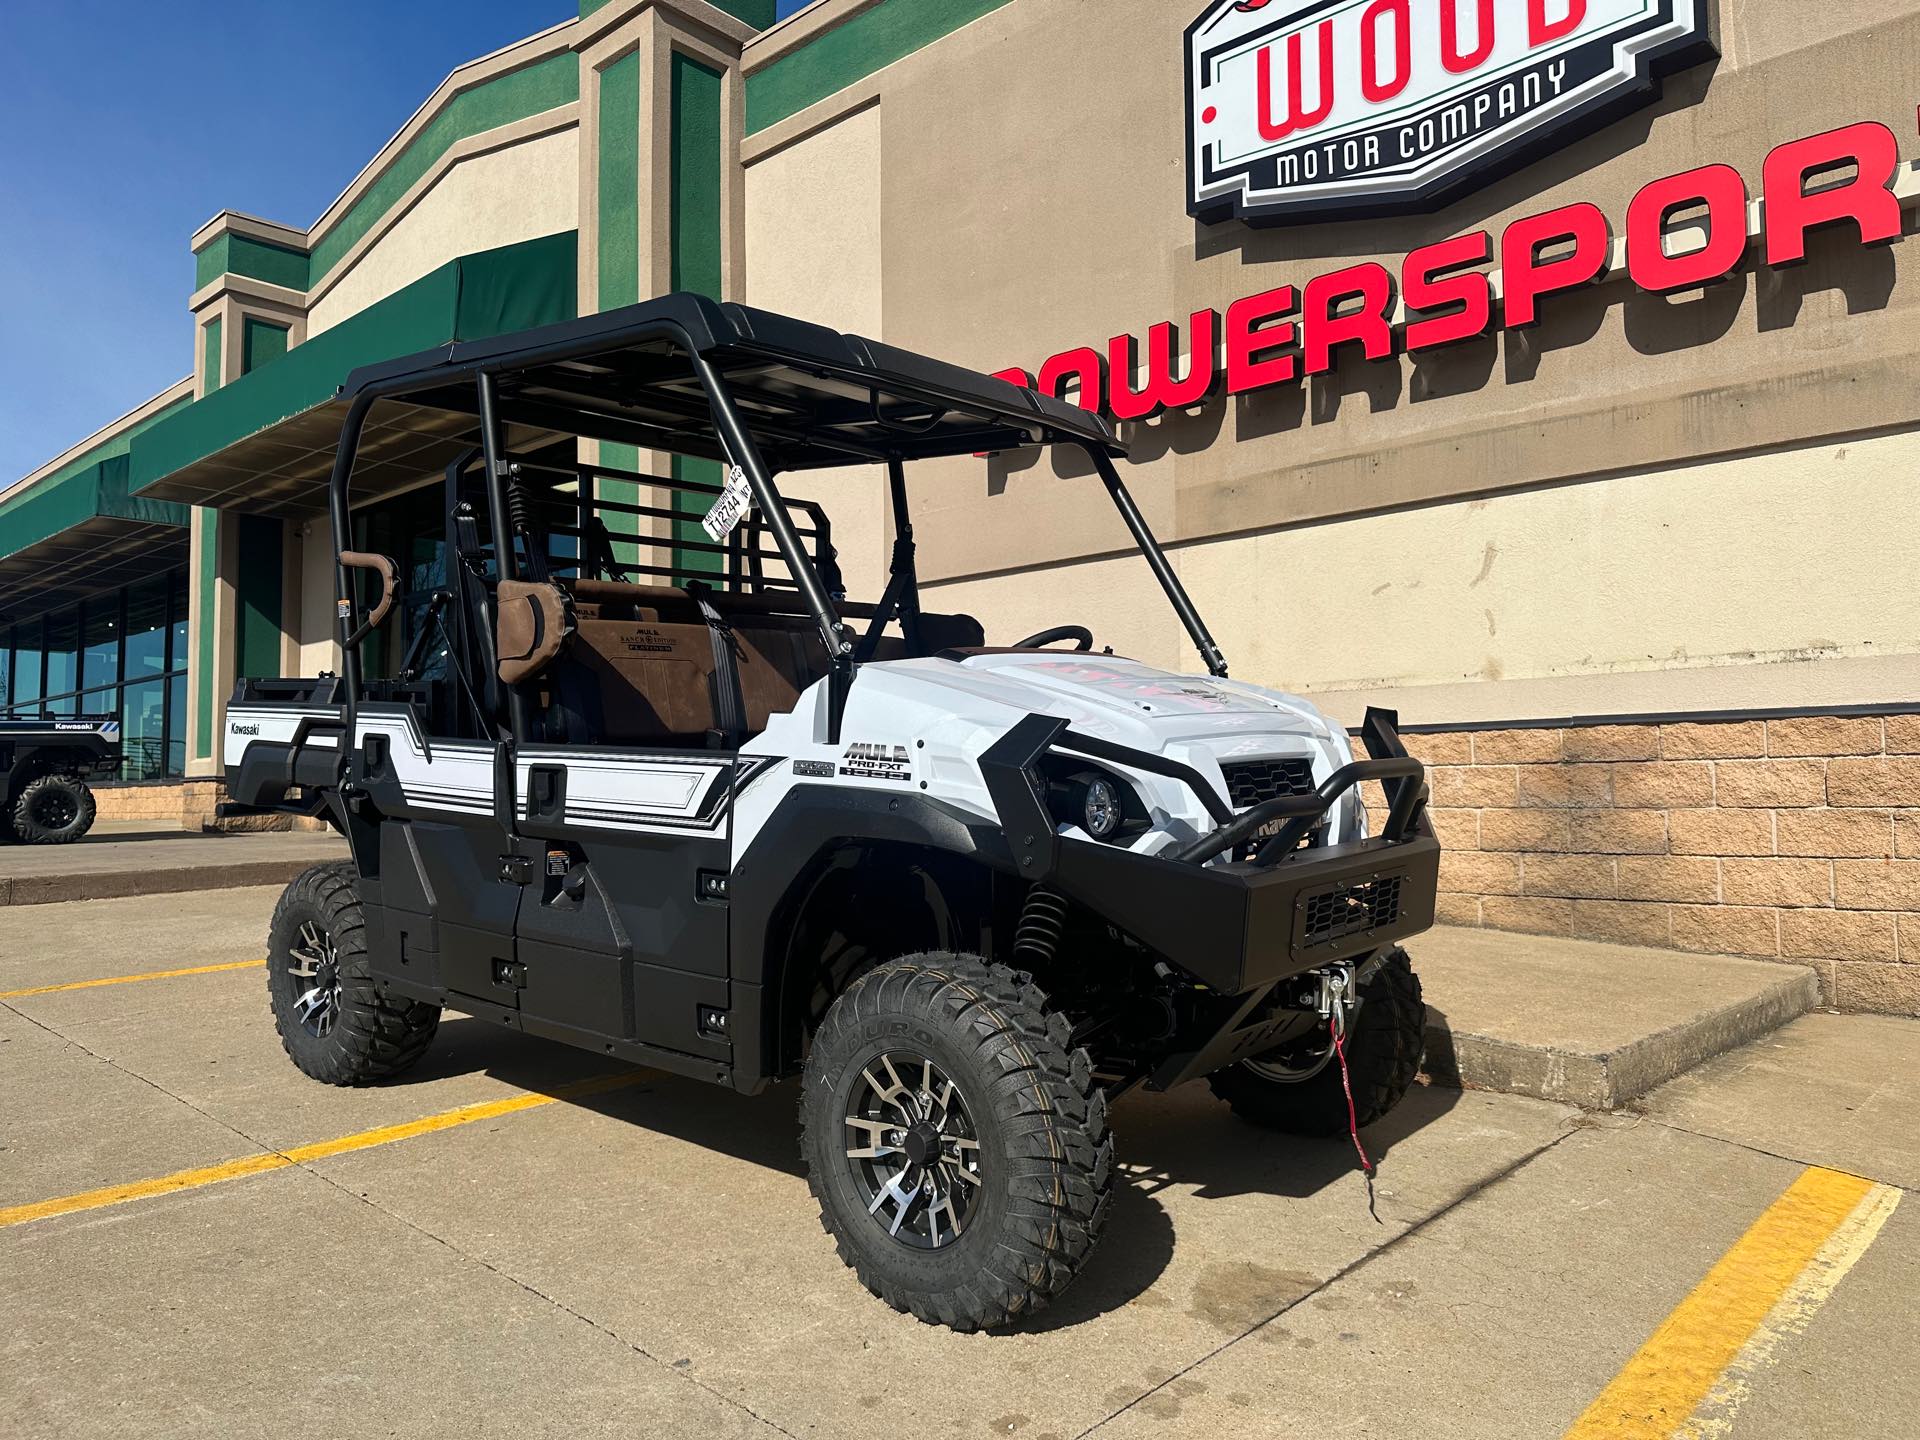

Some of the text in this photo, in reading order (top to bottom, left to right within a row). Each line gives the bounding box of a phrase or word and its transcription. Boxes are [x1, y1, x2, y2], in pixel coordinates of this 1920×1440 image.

[1276, 59, 1566, 186] MOTOR COMPANY
[976, 104, 1920, 457] OWERSPOR
[708, 496, 741, 533] T12744
[231, 722, 260, 736] Kawasaki
[843, 743, 911, 763] MULE
[848, 760, 904, 770] PRO-FXT
[845, 1020, 934, 1055] DURO
